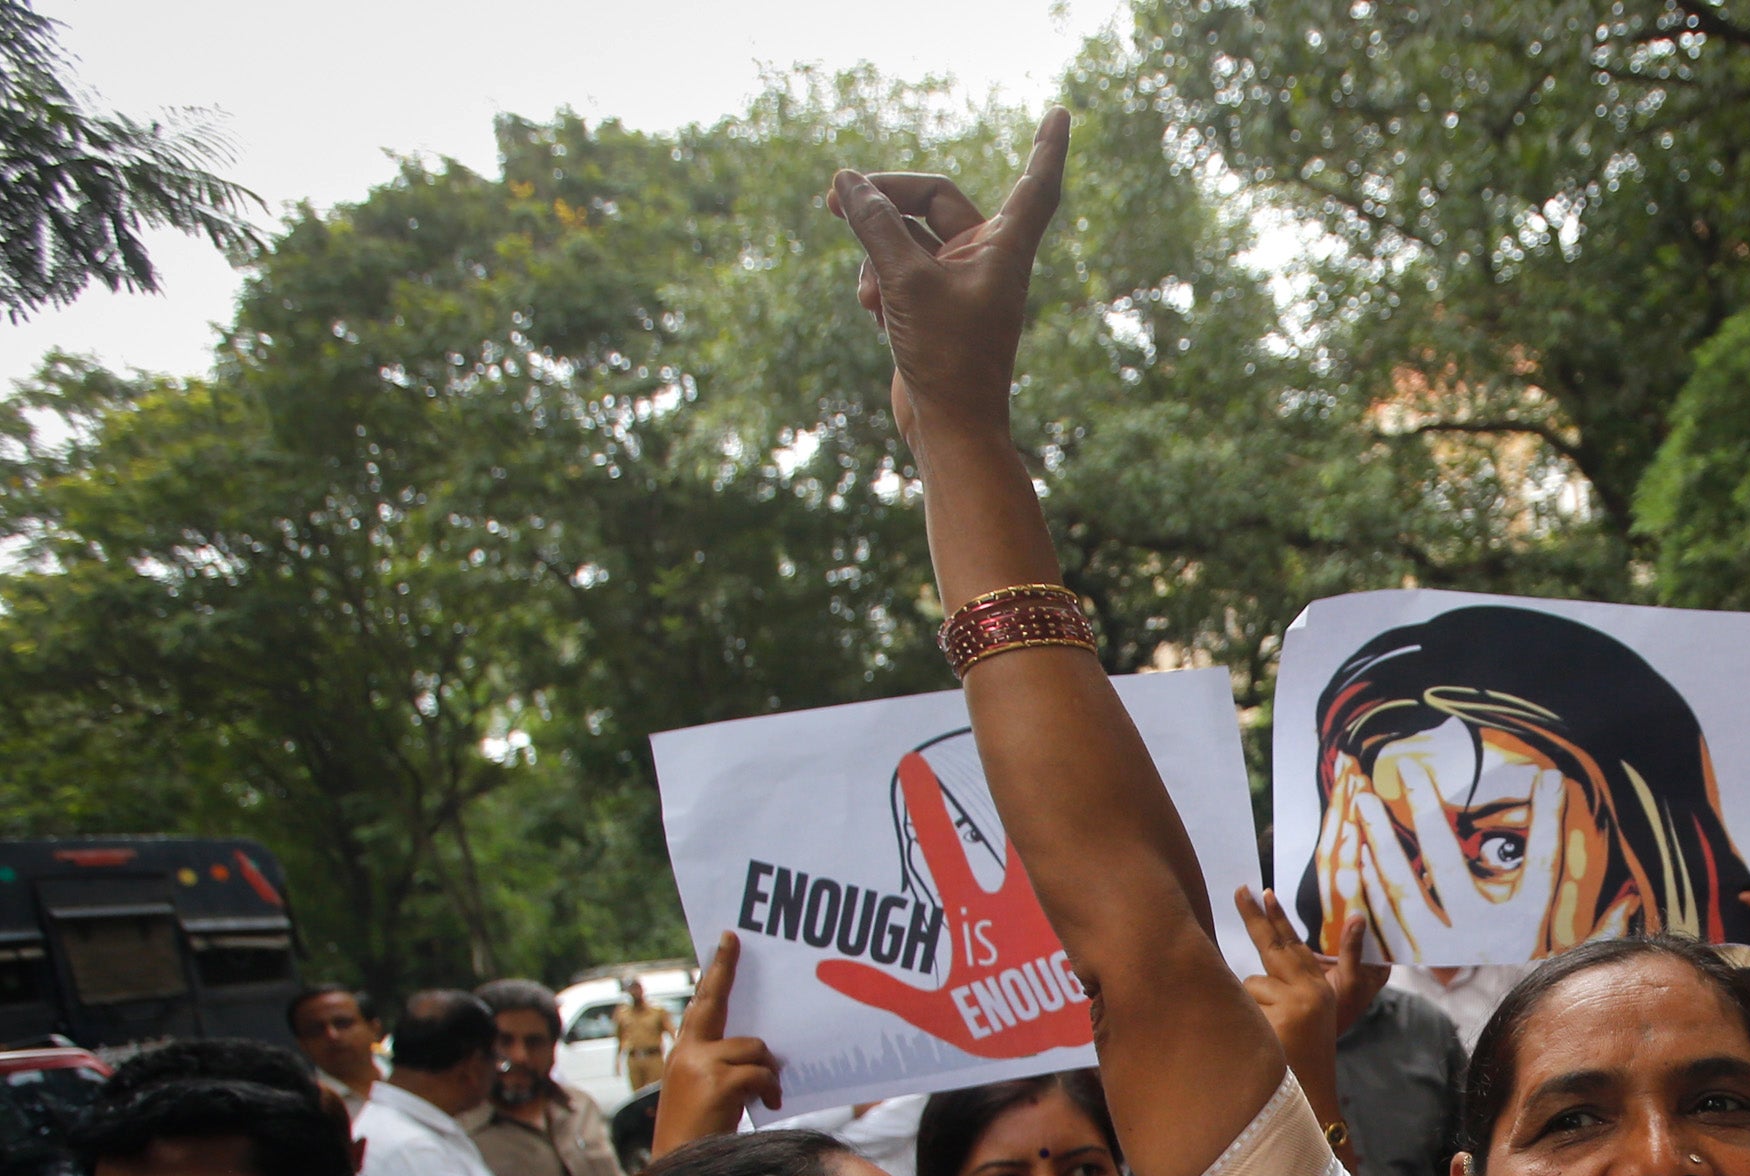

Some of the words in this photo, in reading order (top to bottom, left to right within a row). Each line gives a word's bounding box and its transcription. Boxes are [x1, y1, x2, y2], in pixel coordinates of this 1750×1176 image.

[738, 859, 944, 975] ENOUGH
[960, 906, 998, 967] is
[950, 949, 1089, 1040] ENOUG
